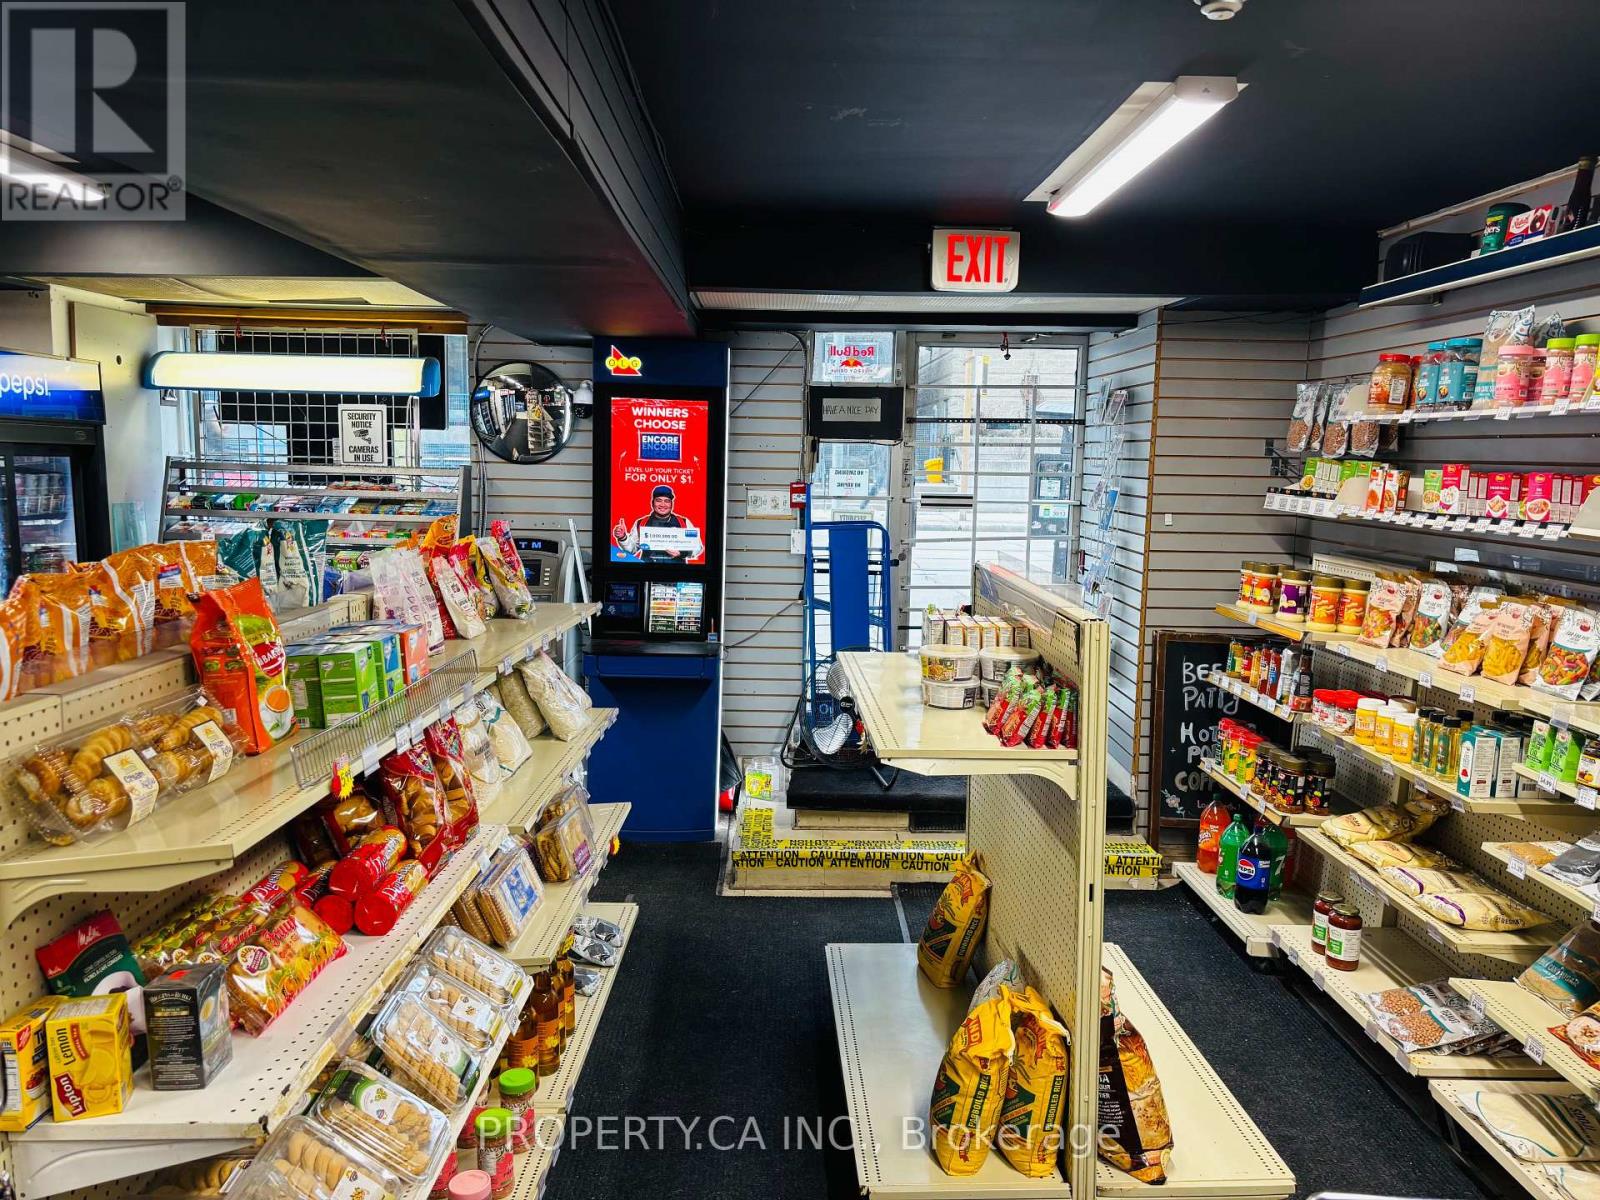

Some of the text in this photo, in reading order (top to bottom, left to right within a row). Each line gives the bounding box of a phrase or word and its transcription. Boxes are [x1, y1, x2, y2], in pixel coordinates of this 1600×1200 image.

[947, 234, 1010, 283] EXIT
[607, 357, 640, 369] OLG
[0, 373, 50, 400] pepsi
[631, 406, 689, 418] WINNERS
[823, 404, 838, 415] HAVE
[847, 404, 861, 415] NICE
[865, 405, 879, 414] DAY
[347, 412, 376, 421] SECURITY
[351, 420, 373, 429] NOTICE
[633, 418, 687, 430] CHOOSE
[641, 435, 679, 444] ENCORE
[348, 445, 379, 454] CAMERAS
[353, 454, 375, 462] IN USE
[625, 473, 647, 482] FOR
[649, 474, 678, 483] ONLY
[1182, 656, 1223, 685] BE
[740, 851, 799, 859] ATTENTION
[810, 851, 858, 860] CAUTION
[865, 852, 924, 861] ATTENTION
[776, 859, 824, 868] CAUTION
[830, 859, 890, 869] ATTENTION
[901, 861, 949, 871] CAUTION
[56, 1028, 76, 1066] Lemon
[1054, 1075, 1064, 1094] RICE
[60, 1076, 84, 1116] Lipton
